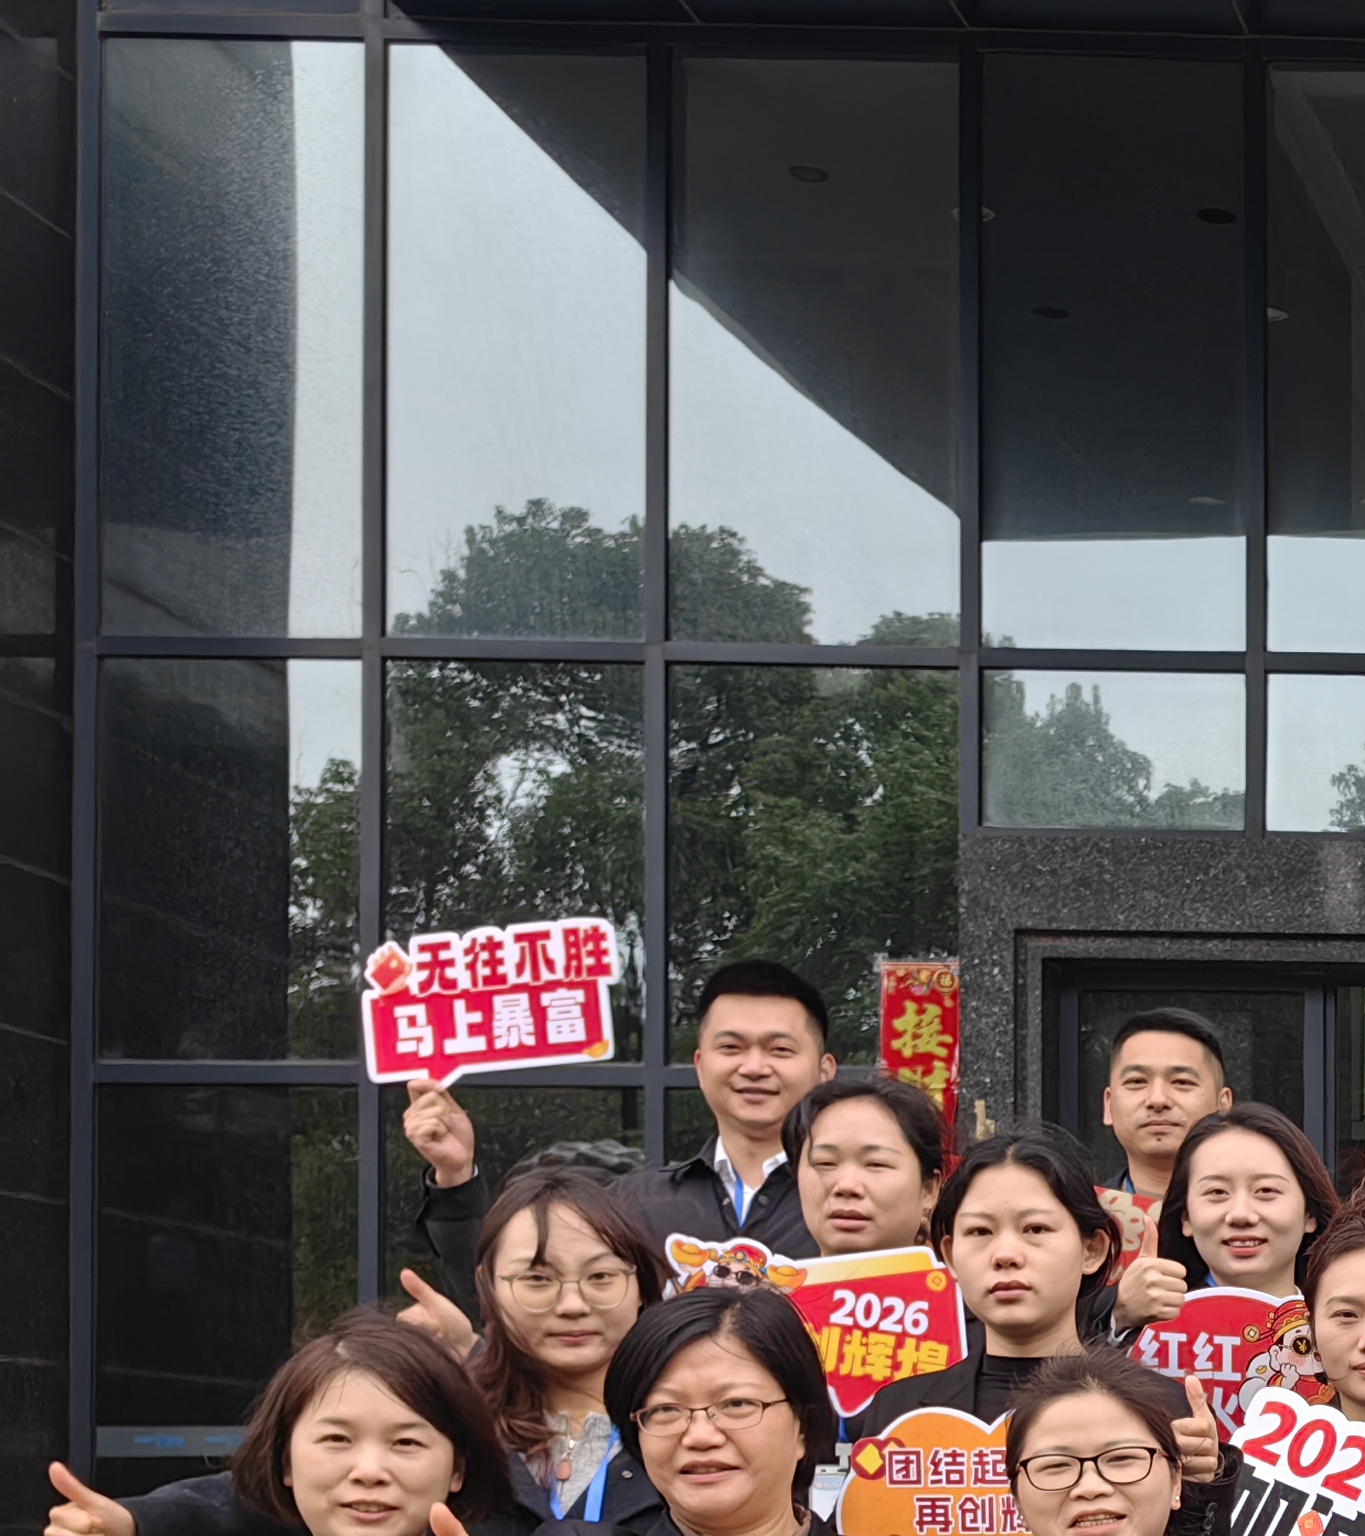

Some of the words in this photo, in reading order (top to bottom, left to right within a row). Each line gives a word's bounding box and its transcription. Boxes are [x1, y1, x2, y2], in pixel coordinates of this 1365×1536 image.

[415, 926, 611, 996] 无往不胜
[394, 989, 587, 1057] 马上暴富
[829, 1289, 928, 1335] 2026
[1139, 1328, 1241, 1380] 红红
